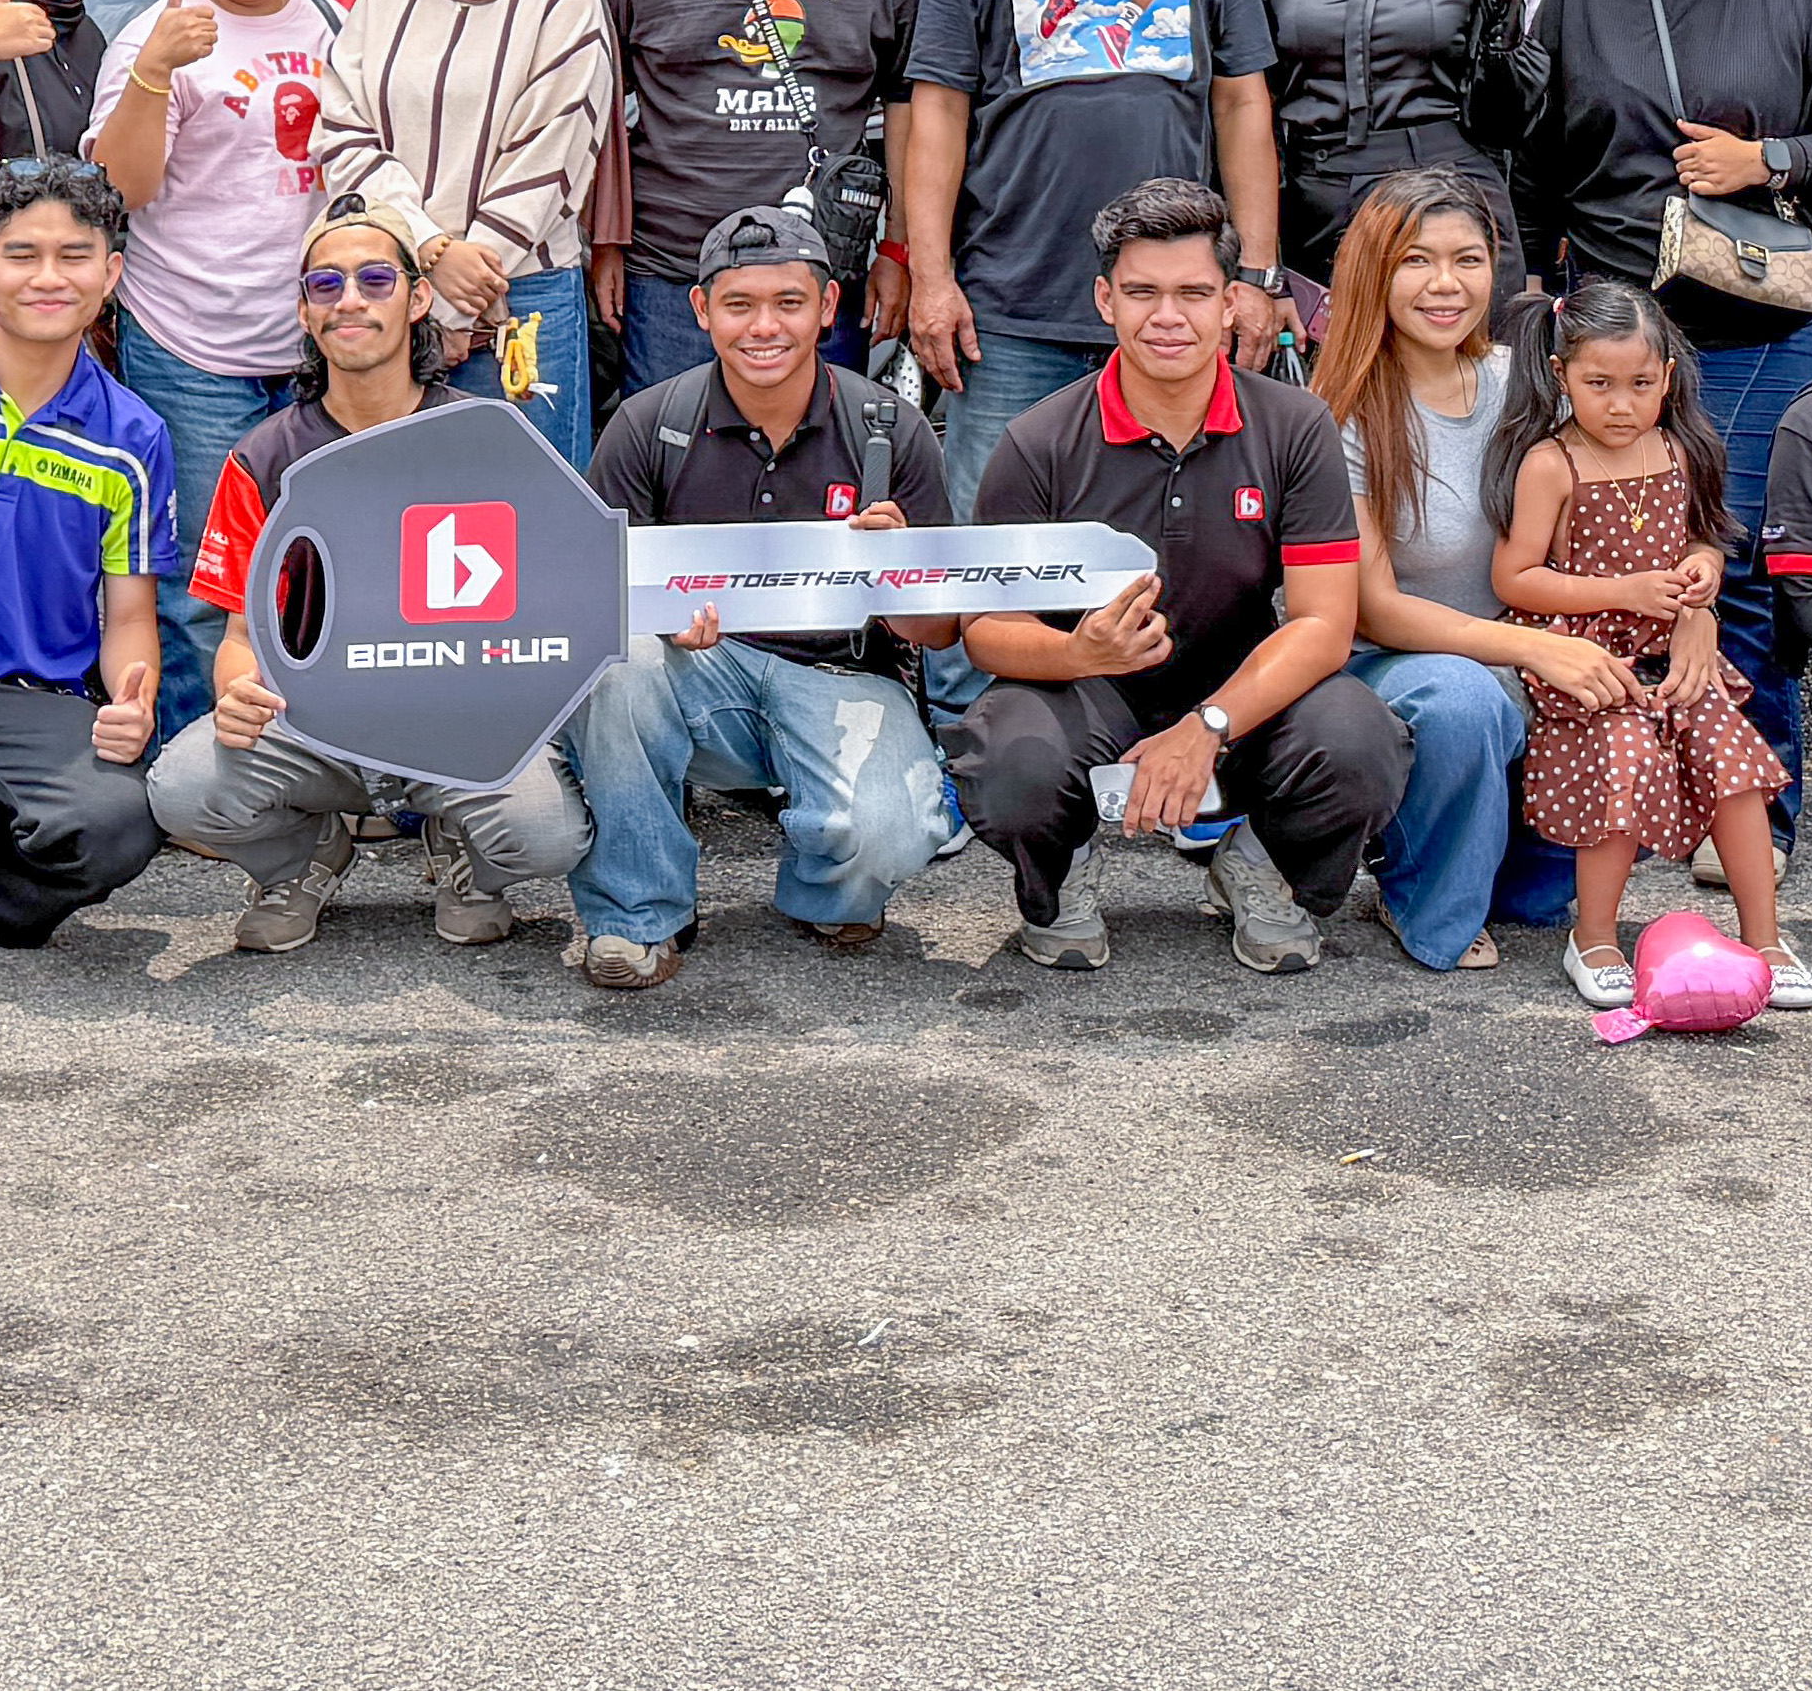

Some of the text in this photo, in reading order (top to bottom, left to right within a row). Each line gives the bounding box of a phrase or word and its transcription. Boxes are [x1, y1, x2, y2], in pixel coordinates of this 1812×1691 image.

[223, 50, 323, 120] A BATHI
[729, 117, 801, 132] DRY ALL
[49, 461, 93, 490] YAMAHA
[346, 637, 569, 669] BOON HUA
